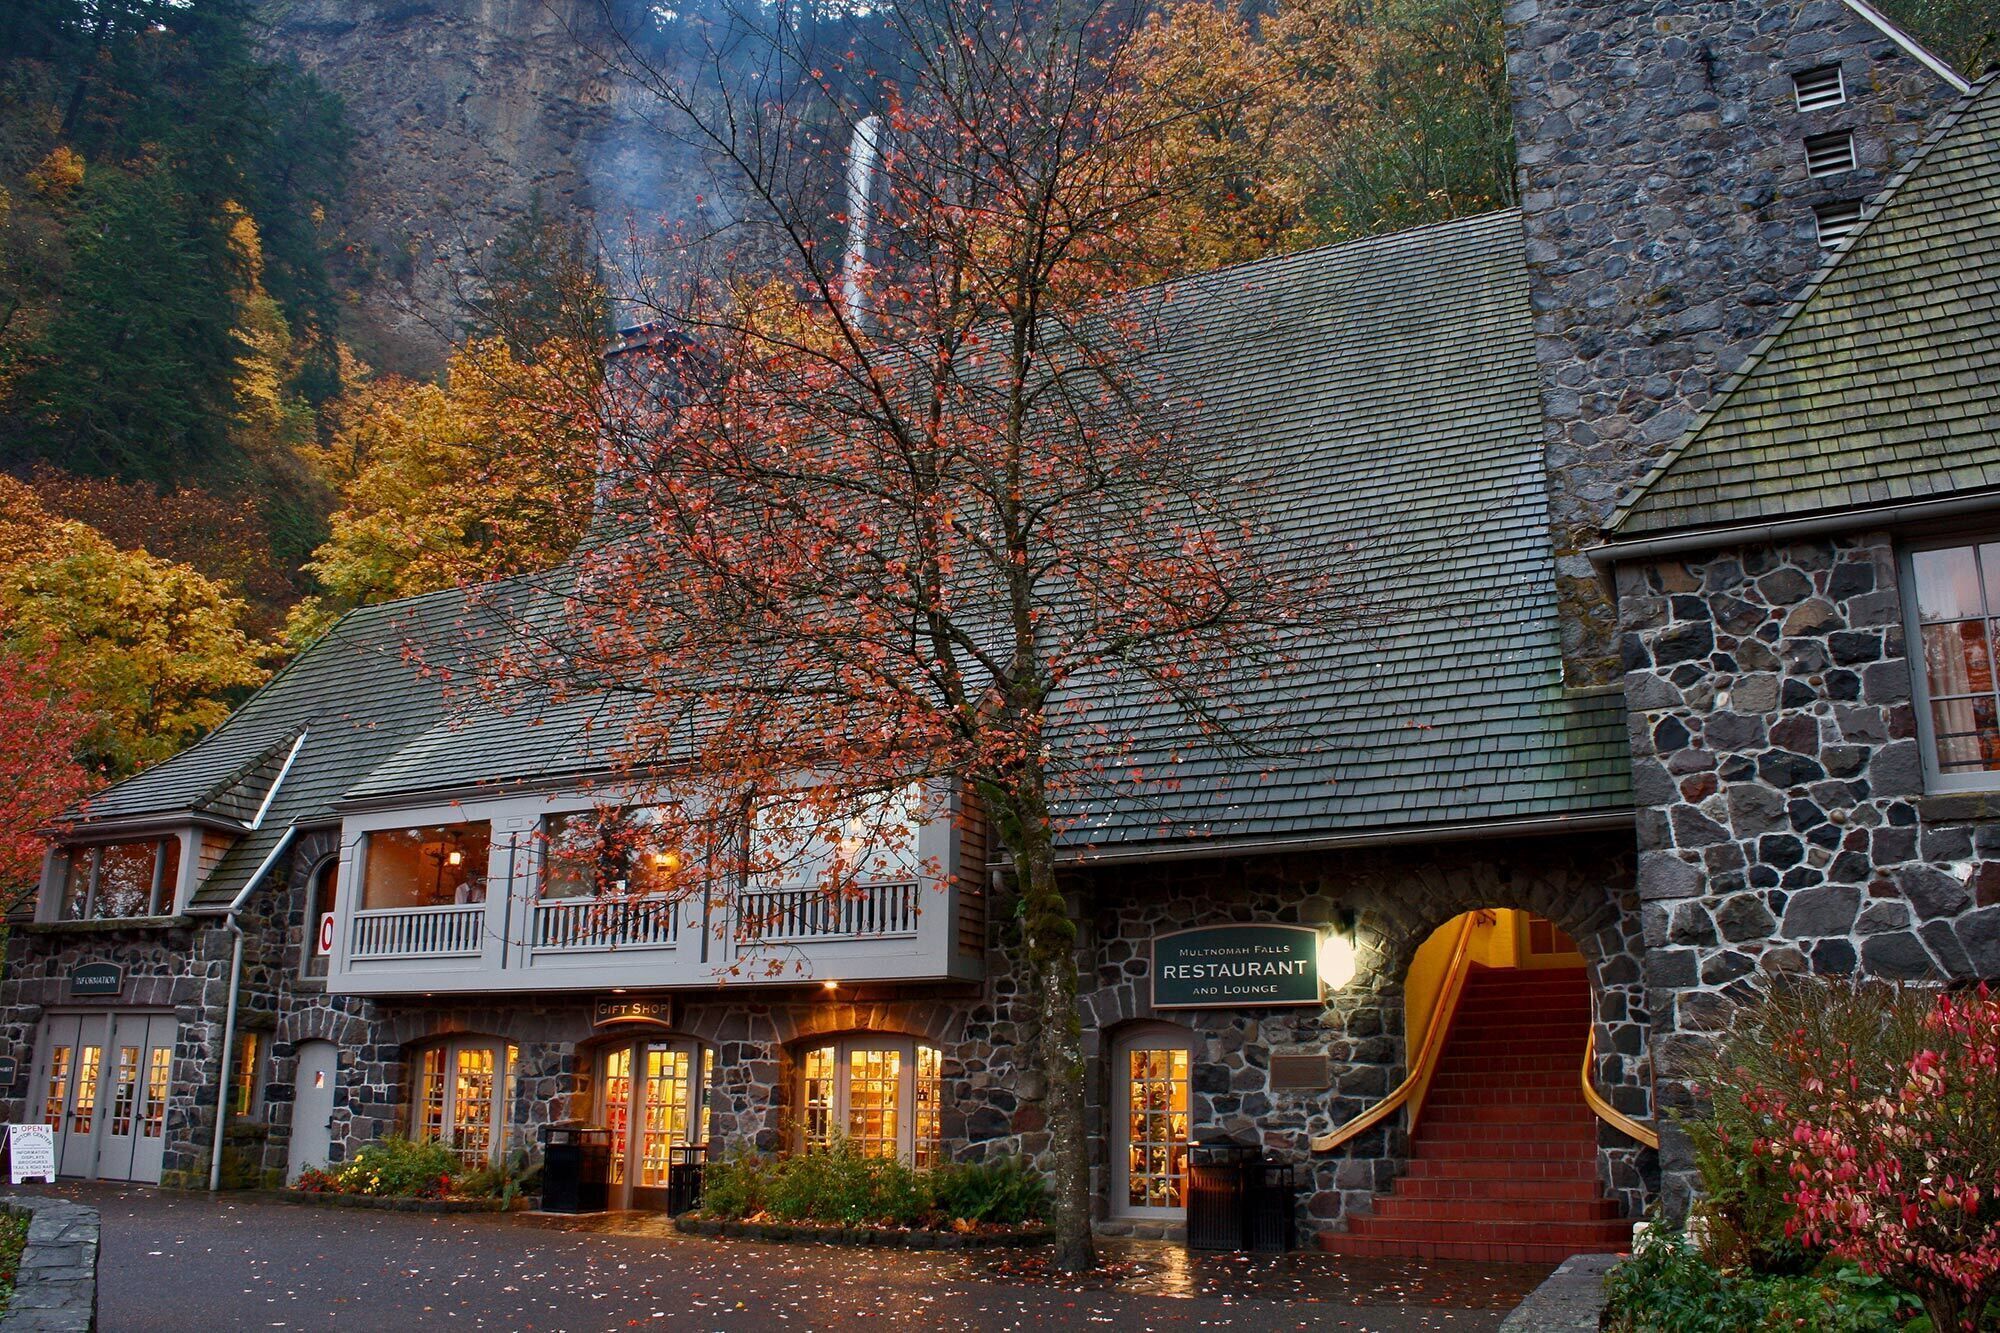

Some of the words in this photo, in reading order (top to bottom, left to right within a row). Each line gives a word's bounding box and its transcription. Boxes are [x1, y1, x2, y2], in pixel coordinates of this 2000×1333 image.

[1179, 948, 1250, 957] MULTNOMAH
[1254, 945, 1291, 954] FALLS
[1163, 960, 1308, 980] RESTAURANT
[75, 976, 117, 985] INFORMATION
[1192, 987, 1218, 996] AND
[1224, 984, 1279, 995] LOUNGE
[598, 1003, 628, 1014] GIFT
[632, 1003, 668, 1014] SHOP
[13, 1132, 31, 1145] VISITOR
[32, 1132, 52, 1145] CENTER
